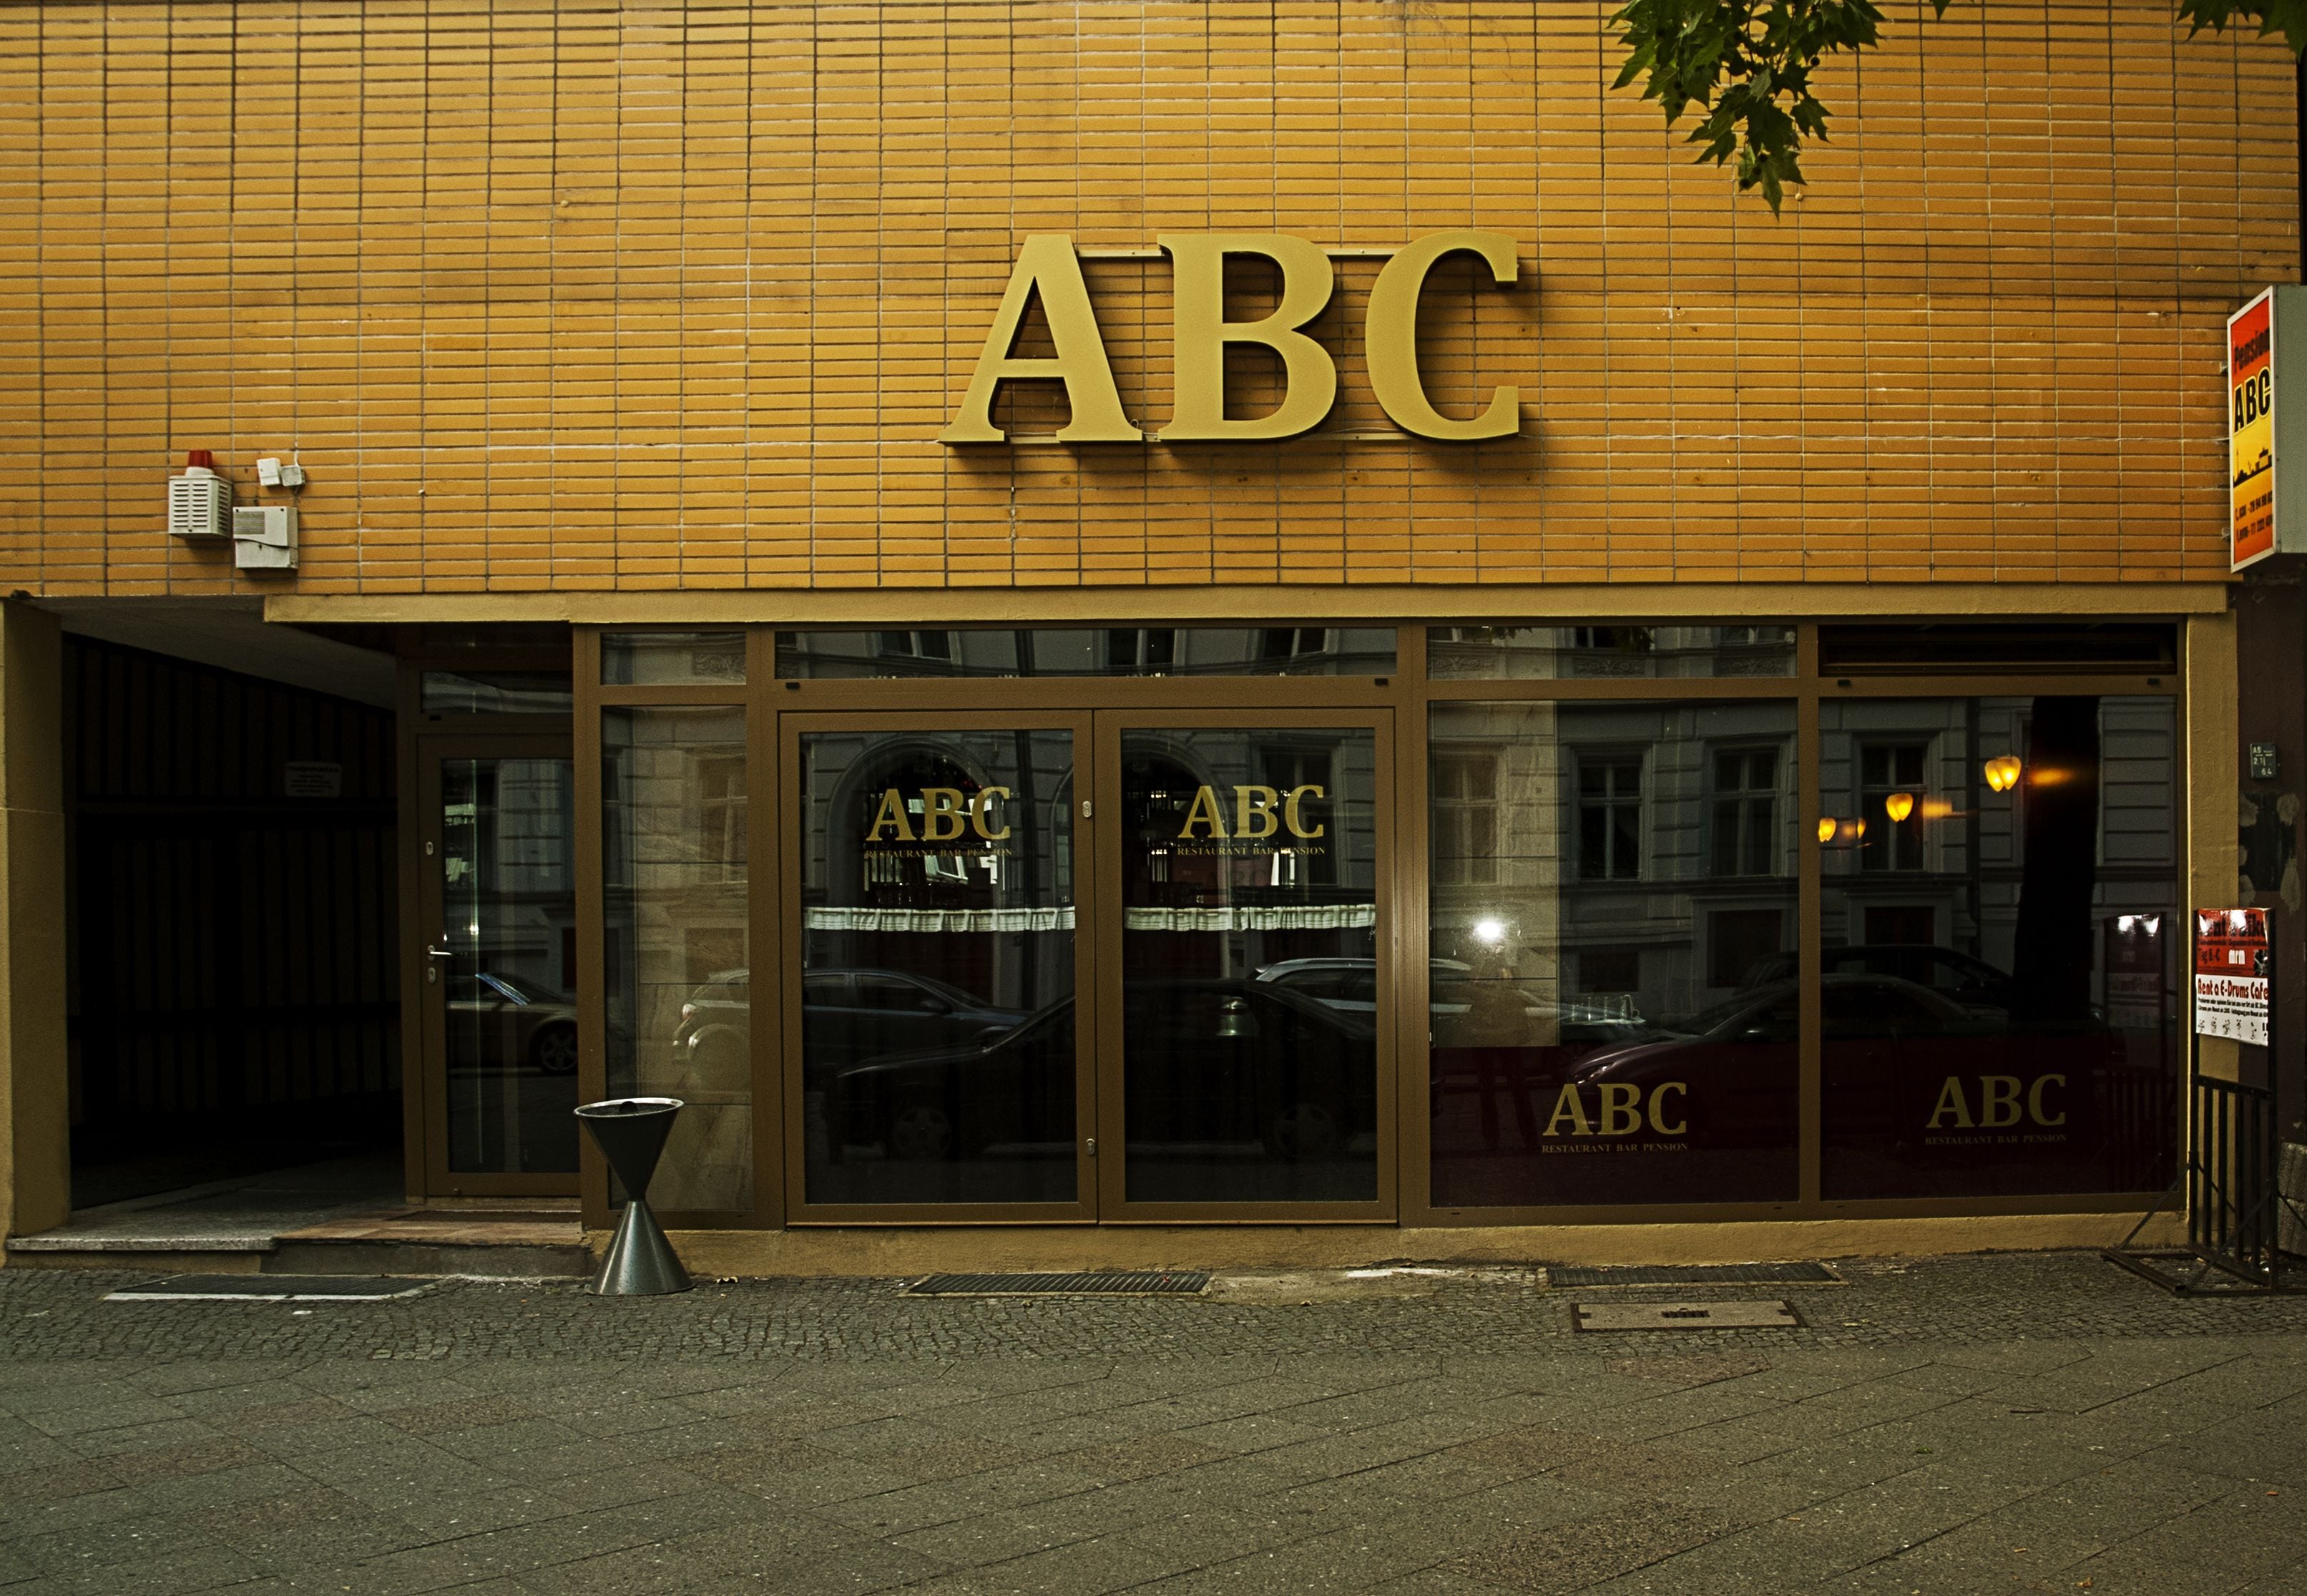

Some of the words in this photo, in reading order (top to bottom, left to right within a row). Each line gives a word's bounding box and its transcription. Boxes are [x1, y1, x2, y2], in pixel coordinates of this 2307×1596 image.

[938, 230, 1519, 443] ABC
[2234, 327, 2271, 373] Pension
[2234, 368, 2271, 433] ABC
[866, 786, 1011, 841] ABC
[1177, 785, 1324, 839] ABC
[865, 849, 933, 858] RESTAURANT
[1177, 847, 1247, 856] RESTAURANT
[2228, 949, 2245, 965] mrm
[2198, 978, 2213, 995] Rent
[2214, 983, 2219, 996] a
[2220, 979, 2249, 998] E-Drums
[1542, 1082, 1688, 1136] ABC
[1925, 1074, 2066, 1129] ABC
[1542, 1144, 1610, 1153] RESTAURANT
[1643, 1142, 1688, 1152] PENSION
[1925, 1135, 1993, 1145] RESTAURANT
[1997, 1135, 2018, 1143] BAR
[2023, 1133, 2067, 1143] PENSION
